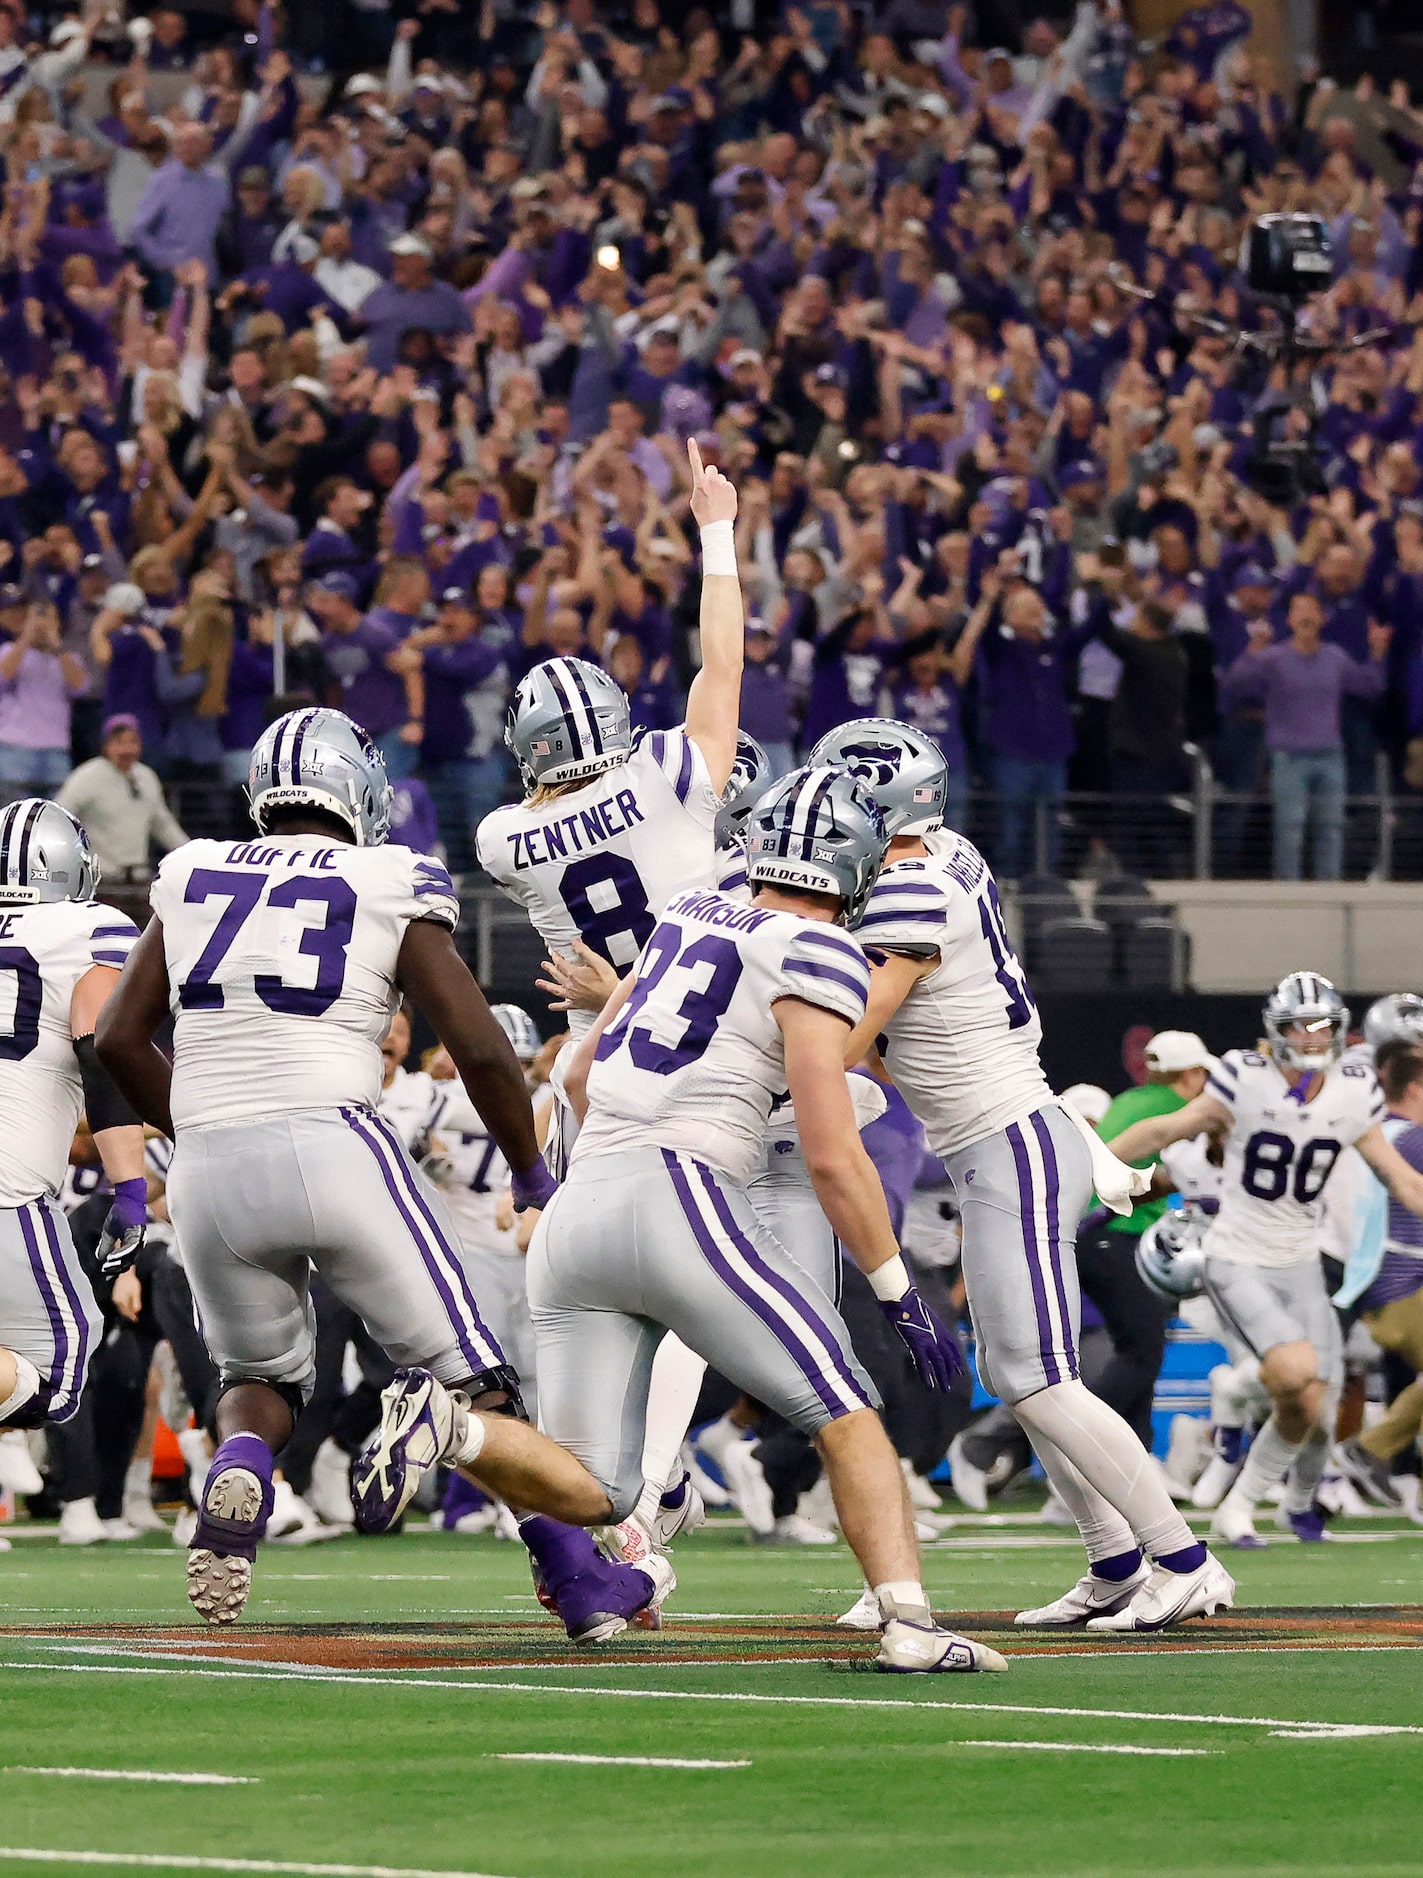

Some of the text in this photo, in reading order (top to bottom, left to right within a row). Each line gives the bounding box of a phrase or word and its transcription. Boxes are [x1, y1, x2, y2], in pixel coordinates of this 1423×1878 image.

[555, 740, 563, 751] 8
[556, 754, 624, 781] WILDCATS
[266, 790, 309, 800] WILDCATS
[933, 790, 942, 802] 19
[507, 789, 645, 871] ZENTNER
[225, 843, 347, 870] DUFFIE
[762, 838, 776, 851] 83
[755, 866, 830, 889] WILDCATS
[558, 850, 657, 981] 8
[178, 867, 358, 1018] 73
[593, 921, 744, 1076] 83
[1242, 1130, 1342, 1204] 80
